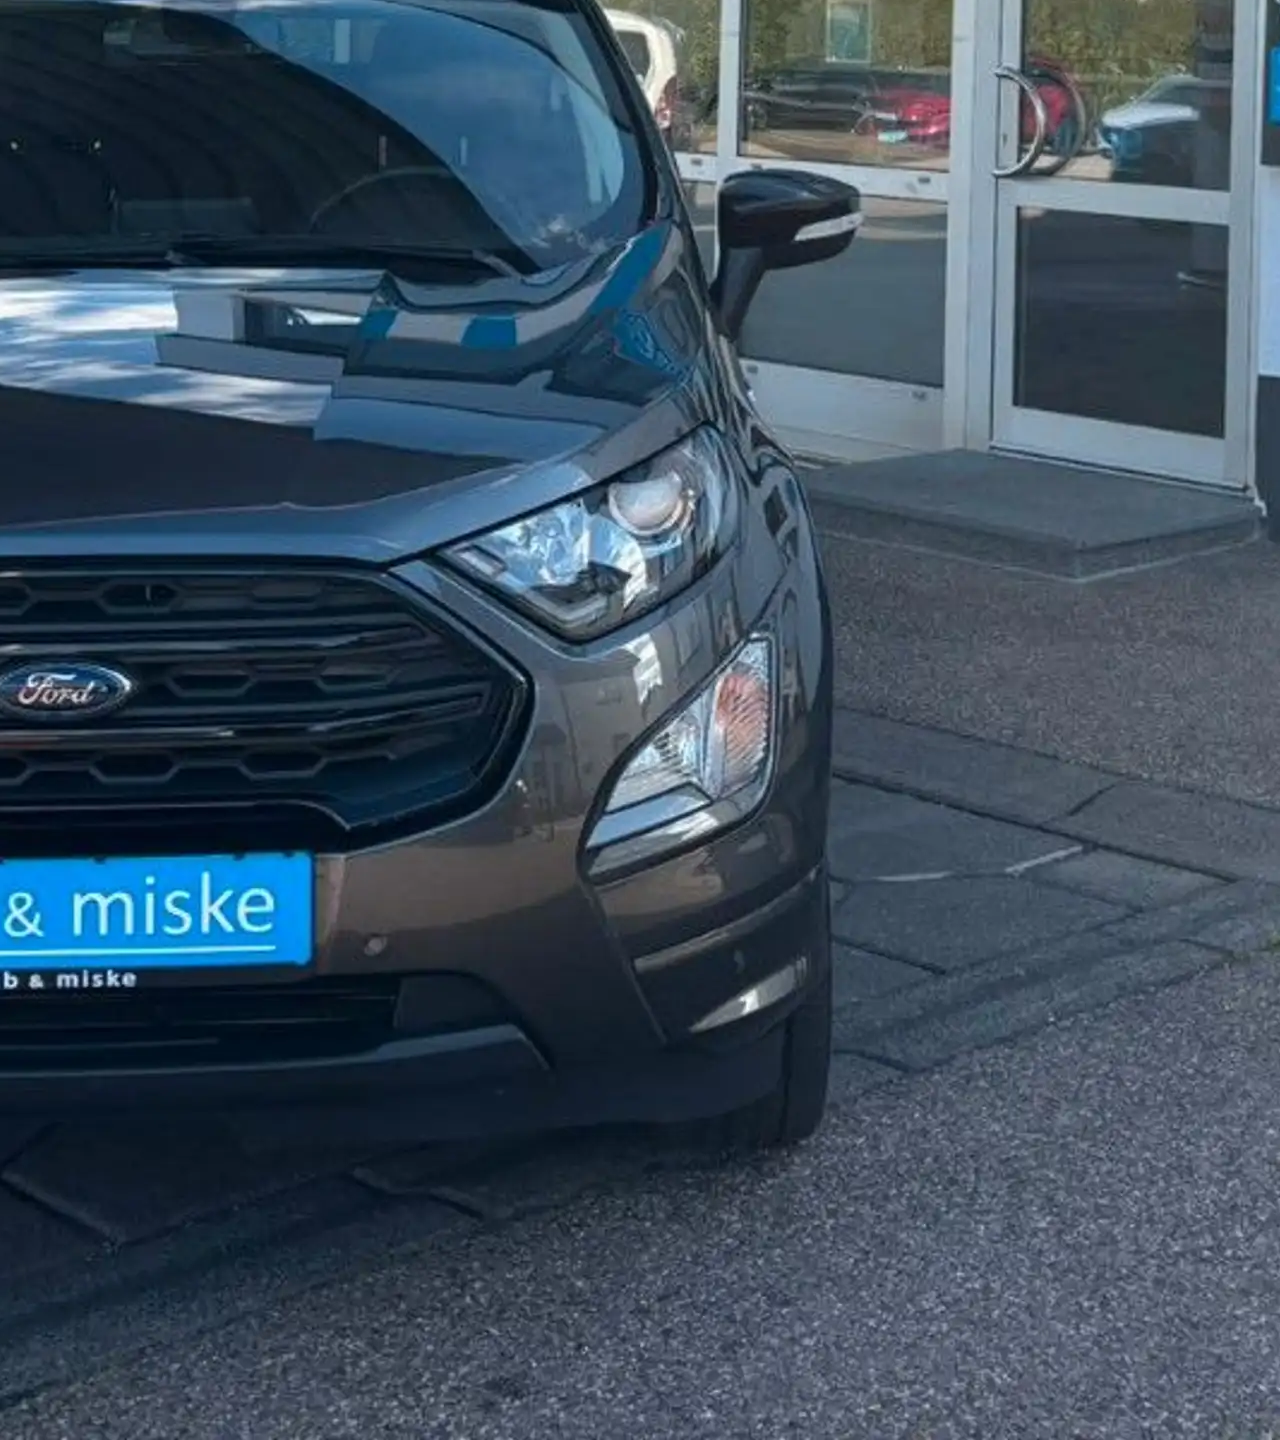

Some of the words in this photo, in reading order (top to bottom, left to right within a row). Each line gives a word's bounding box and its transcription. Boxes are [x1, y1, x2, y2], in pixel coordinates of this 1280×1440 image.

[18, 672, 96, 704] Ford
[2, 891, 45, 939] &
[72, 871, 276, 938] miske
[28, 973, 44, 990] &
[56, 969, 137, 989] miske
